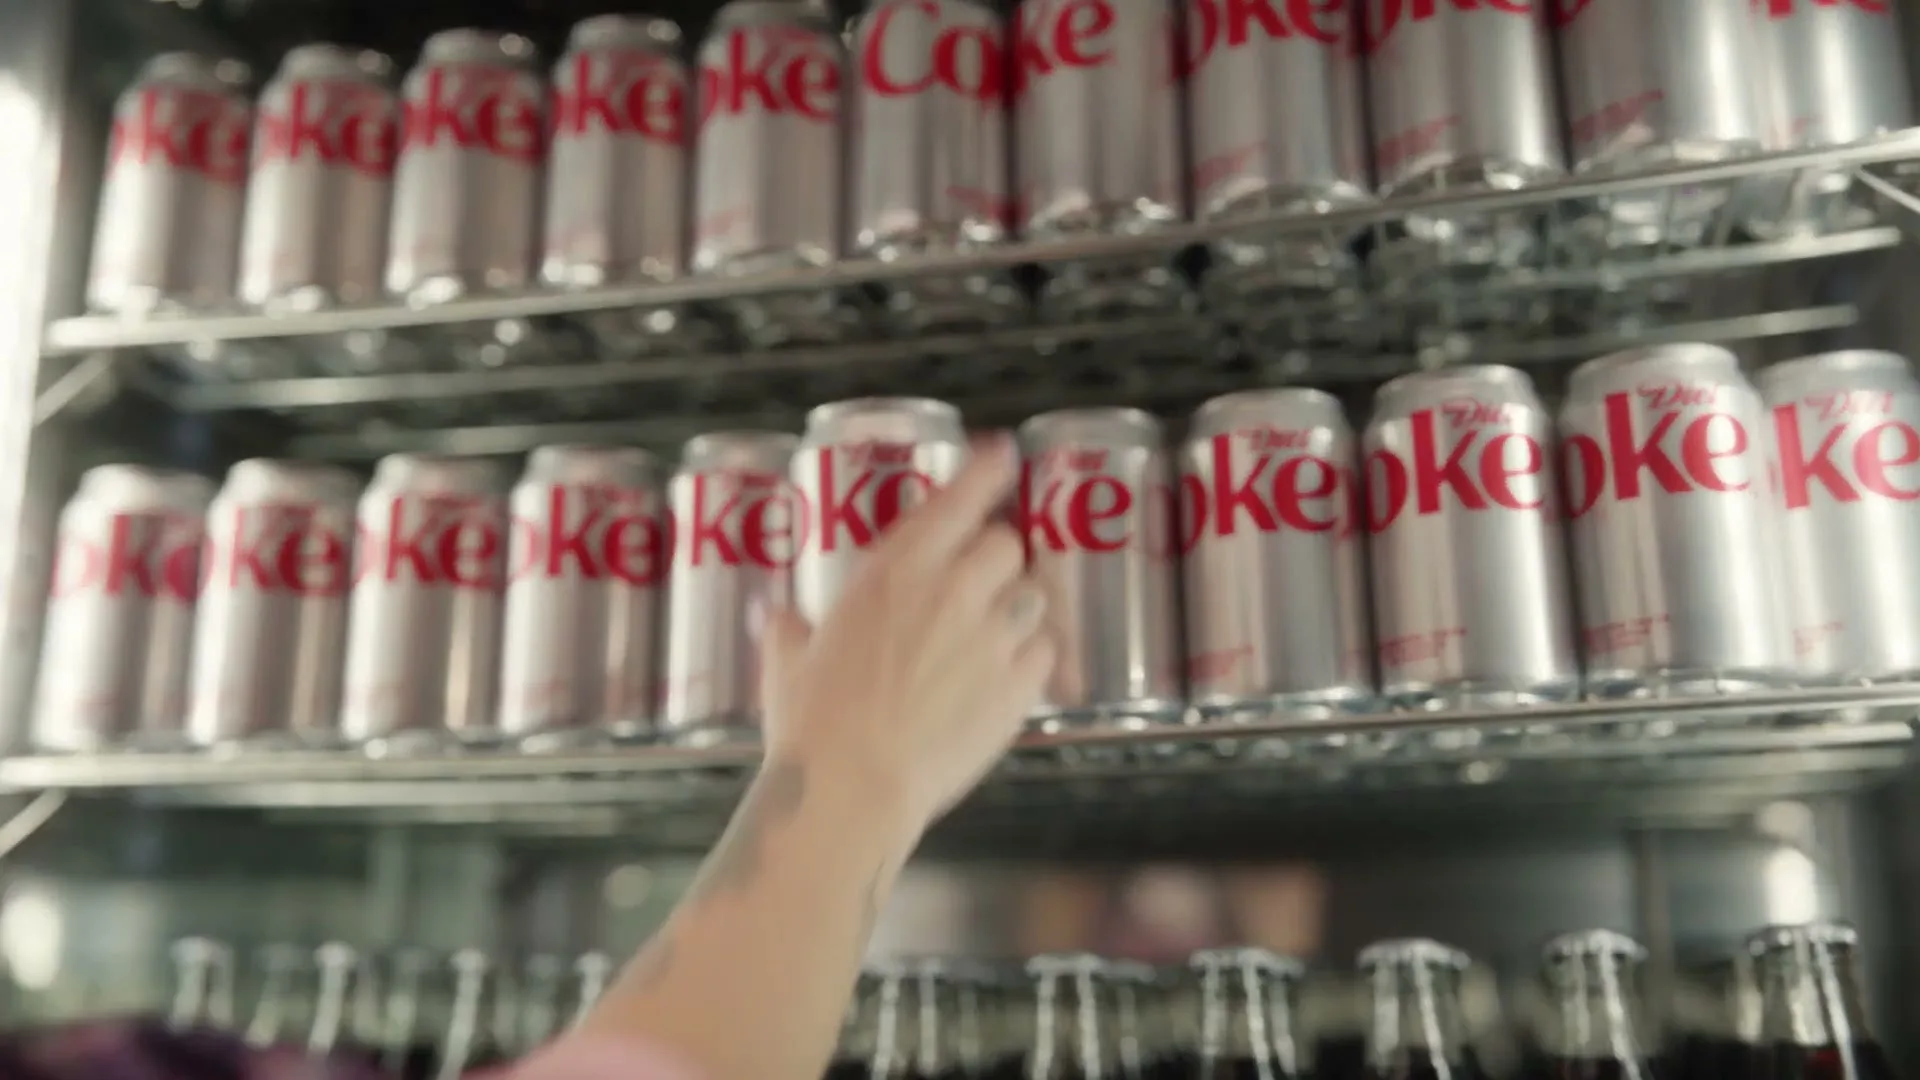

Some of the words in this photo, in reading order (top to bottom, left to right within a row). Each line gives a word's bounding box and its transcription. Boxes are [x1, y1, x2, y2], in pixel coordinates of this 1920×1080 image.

[111, 89, 246, 188] ke
[254, 82, 396, 182] ke
[402, 68, 543, 167] ke
[551, 53, 685, 146] ke
